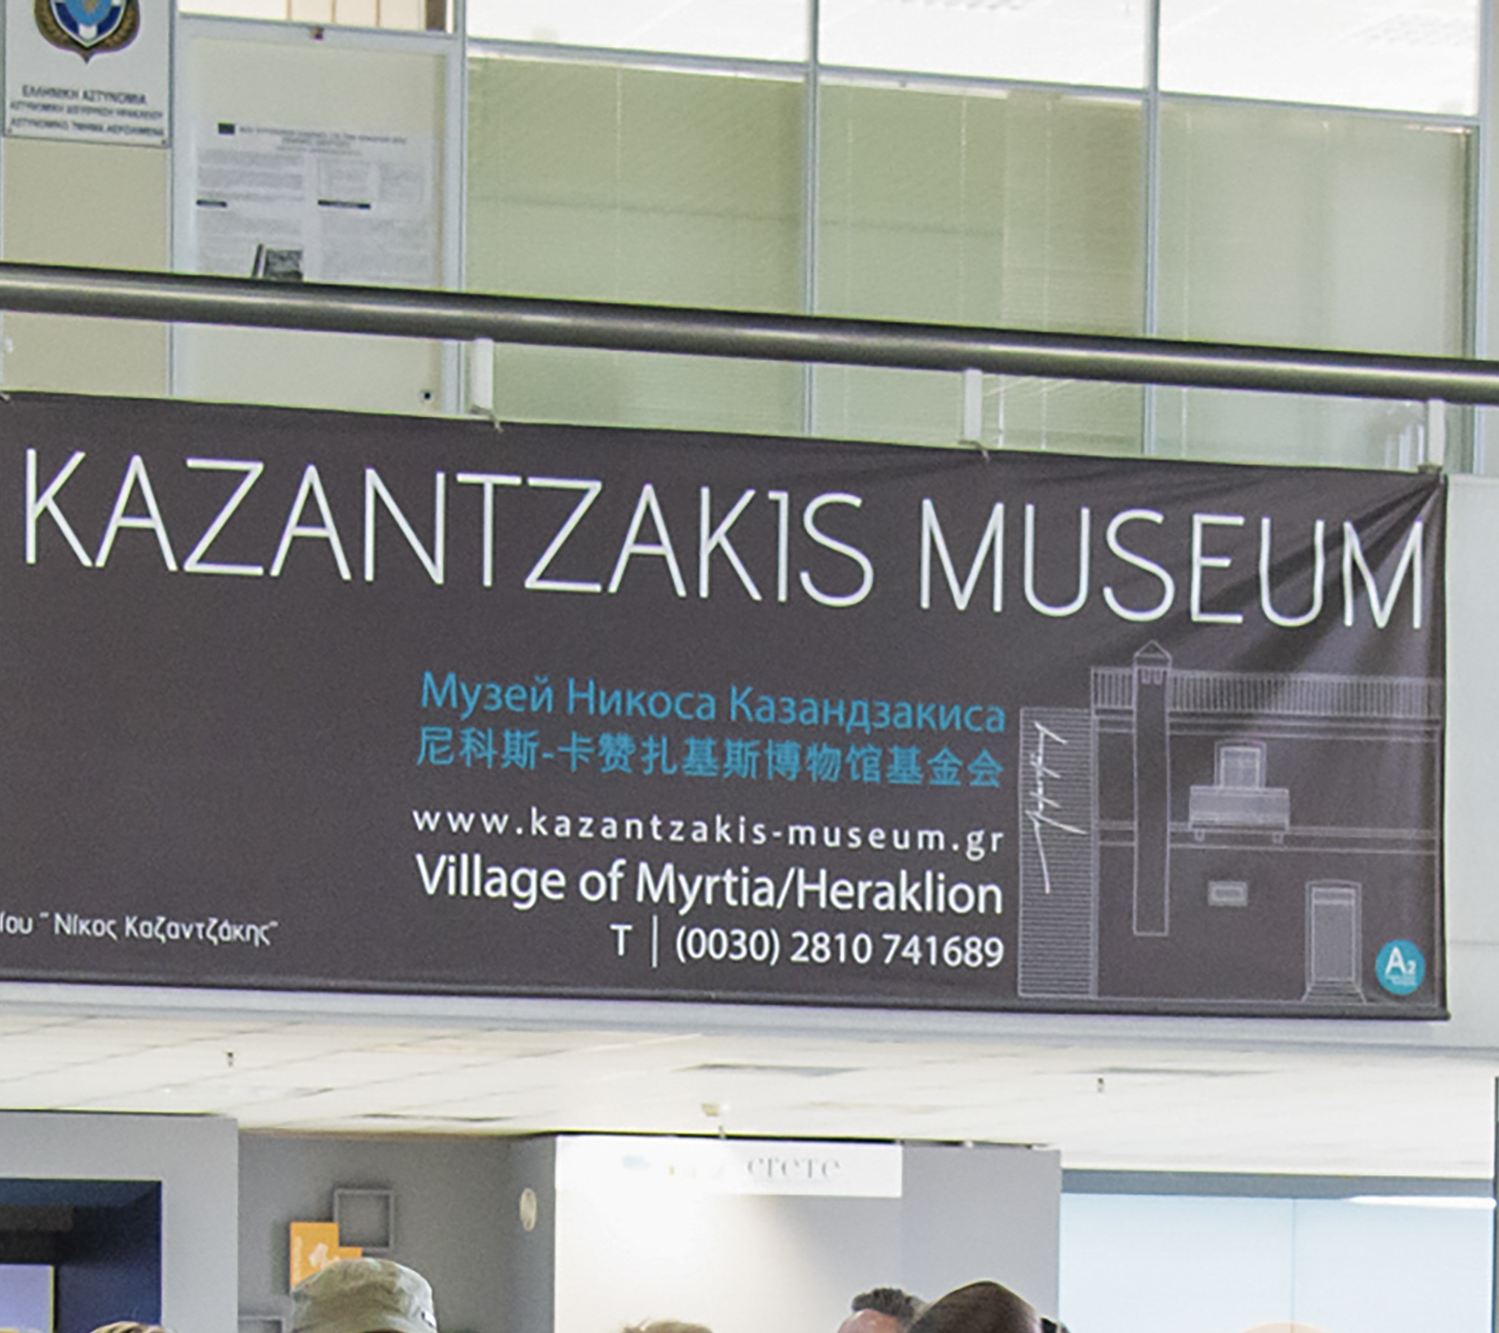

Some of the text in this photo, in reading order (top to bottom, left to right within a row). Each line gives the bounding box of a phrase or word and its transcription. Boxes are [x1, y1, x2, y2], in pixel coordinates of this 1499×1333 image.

[24, 448, 876, 608] KAZANTZAKIS
[918, 498, 1426, 630] MUSEUM
[421, 670, 1006, 735] Музей Никоса Казандзакиса
[416, 725, 1004, 788] 尼科斯-卡赞扎基斯博物馆基金会
[412, 806, 1004, 861] www.kazantzakis-museum.gr
[416, 853, 1003, 915] Village of Myrtia/Heraklion
[611, 924, 1004, 968] T (0030) 2810 741689
